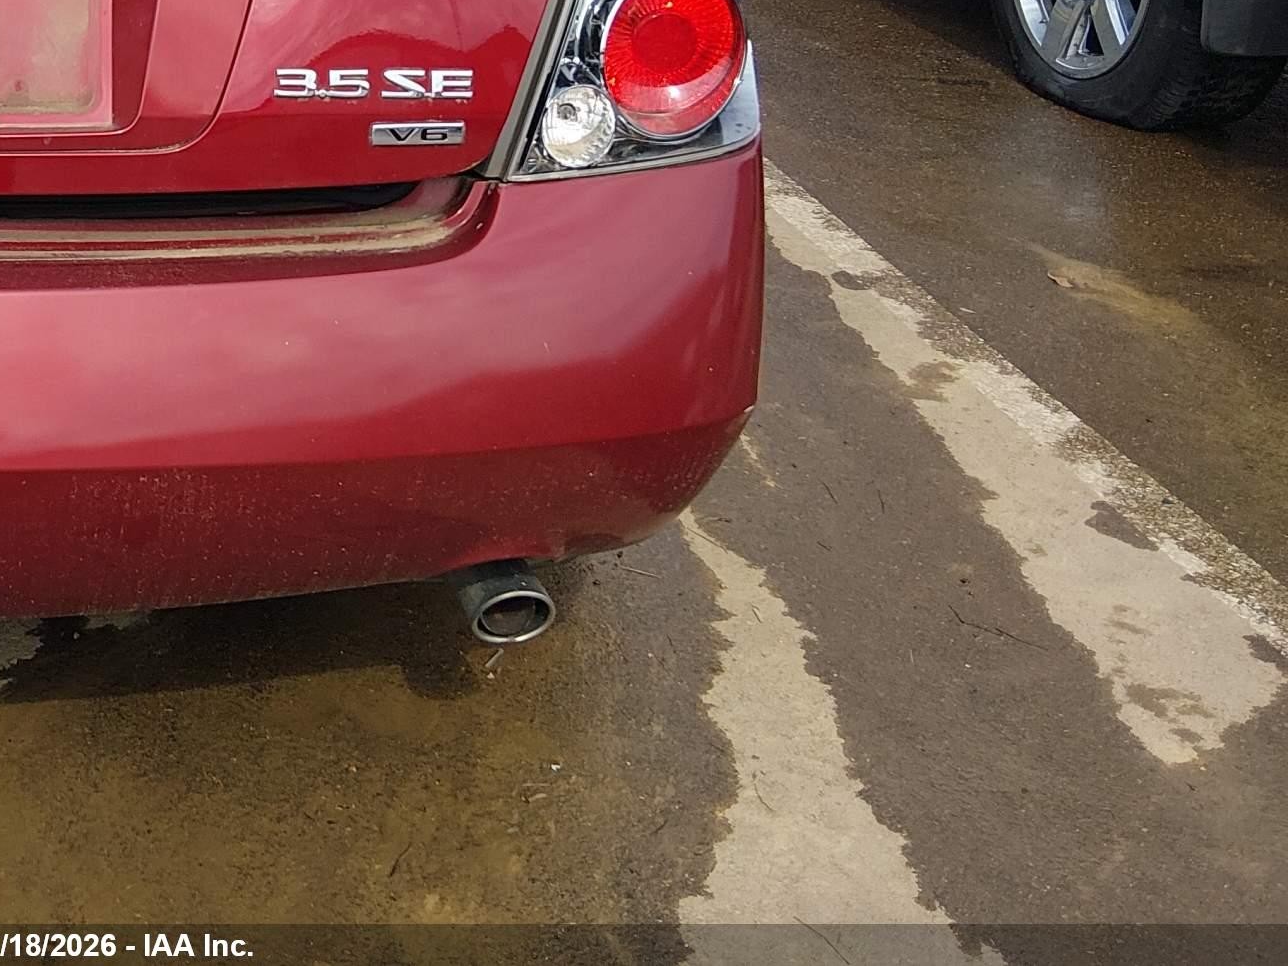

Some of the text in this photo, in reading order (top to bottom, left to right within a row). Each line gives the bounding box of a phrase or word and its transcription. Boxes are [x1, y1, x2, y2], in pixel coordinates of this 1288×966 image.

[273, 68, 474, 99] 3.5 SE
[386, 127, 449, 142] V6
